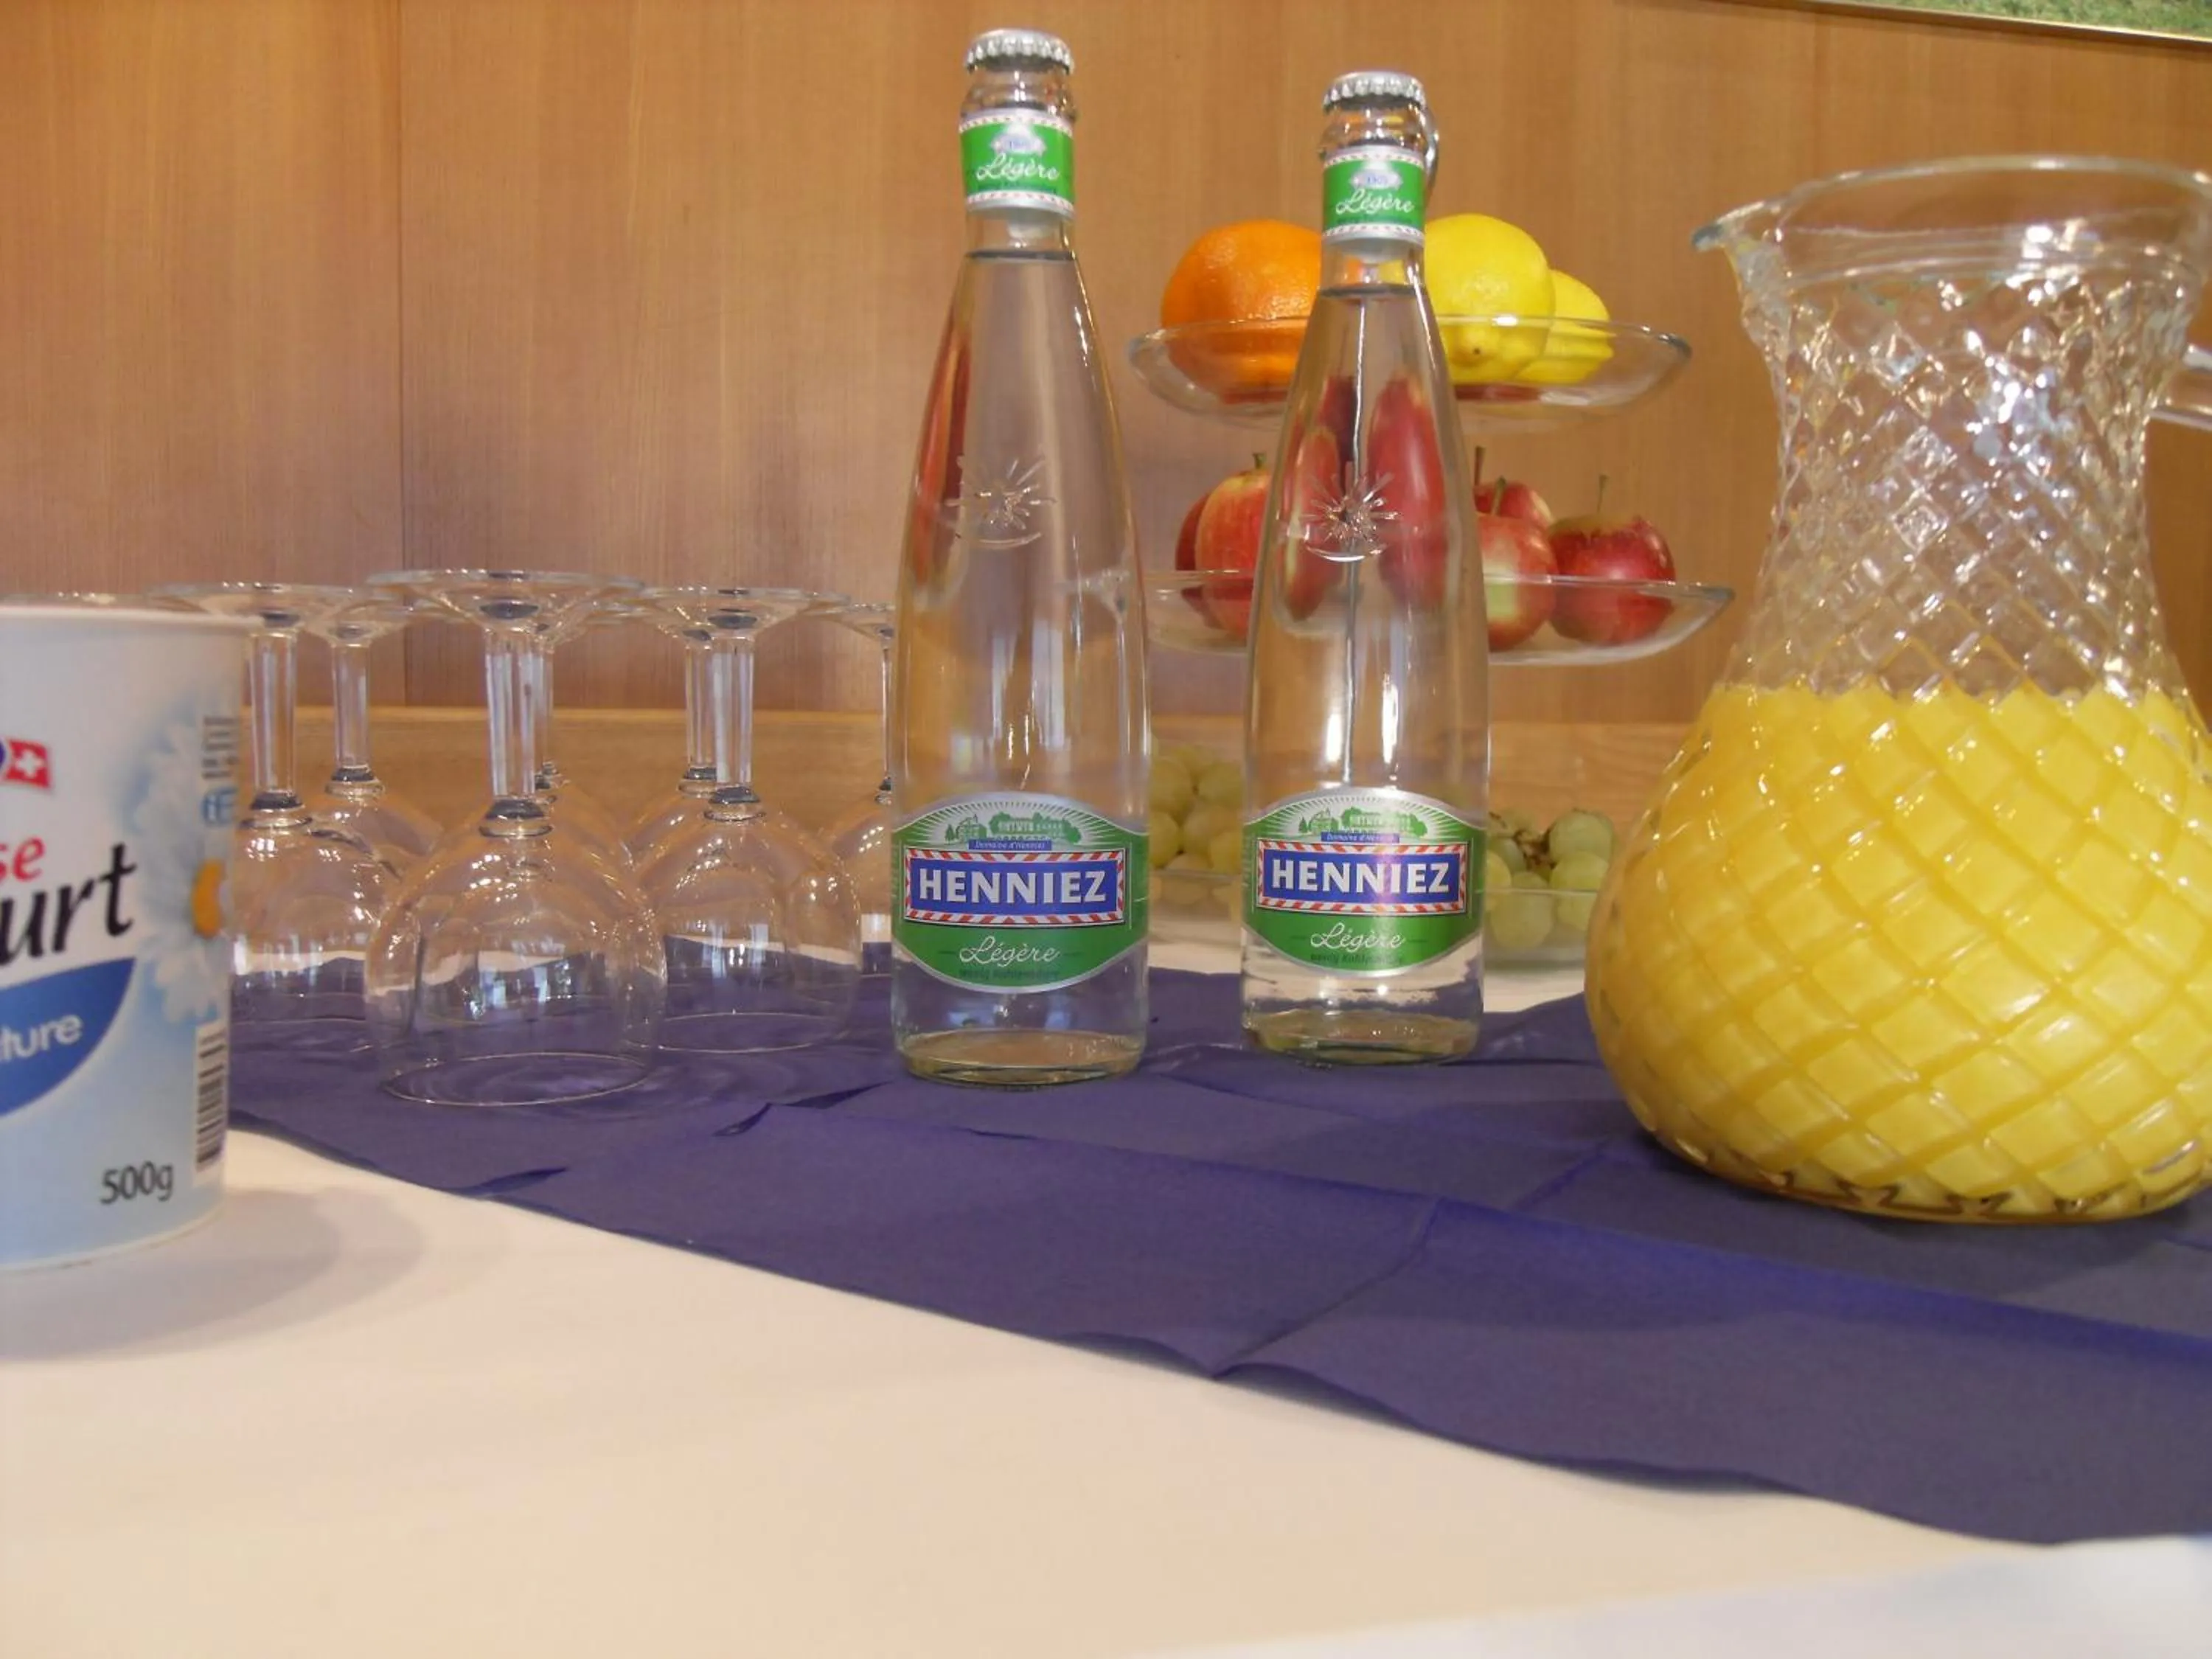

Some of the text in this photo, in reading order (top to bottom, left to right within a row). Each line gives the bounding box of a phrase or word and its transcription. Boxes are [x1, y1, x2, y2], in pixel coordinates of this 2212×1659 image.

[1335, 188, 1415, 215] Légère
[919, 868, 1107, 904] HENNIEZ
[1272, 858, 1450, 894] HENNIEZ
[959, 935, 1061, 967] Légère
[1310, 922, 1406, 953] Légère
[99, 1160, 174, 1206] 500g
